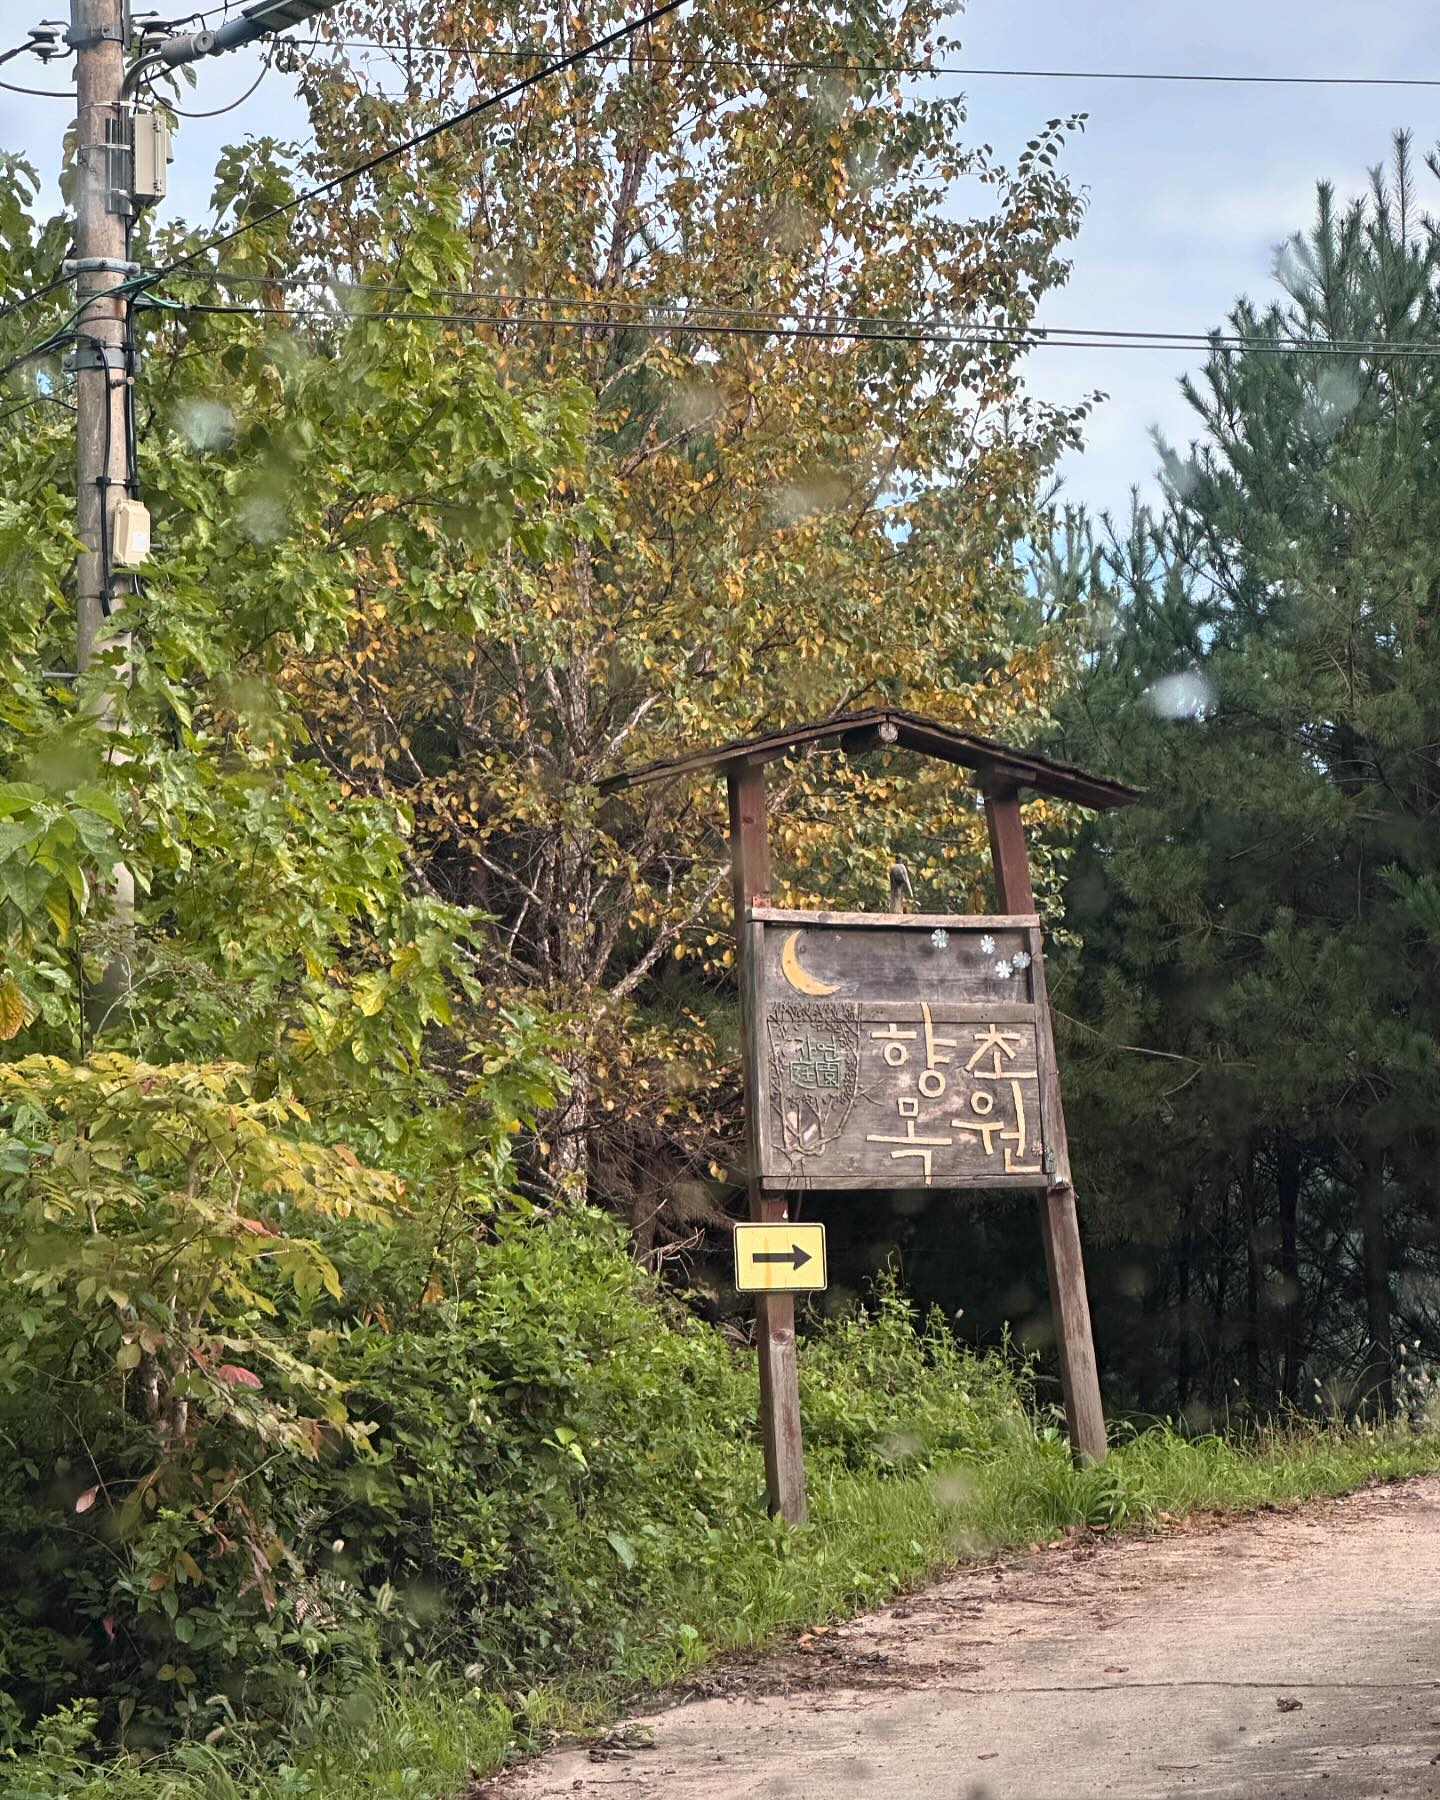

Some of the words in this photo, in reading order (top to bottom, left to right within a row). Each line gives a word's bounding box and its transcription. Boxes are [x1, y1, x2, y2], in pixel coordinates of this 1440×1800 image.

[790, 1061, 840, 1090] 庭園
[871, 1002, 1038, 1098] 향초
[867, 1080, 1041, 1185] 목원
